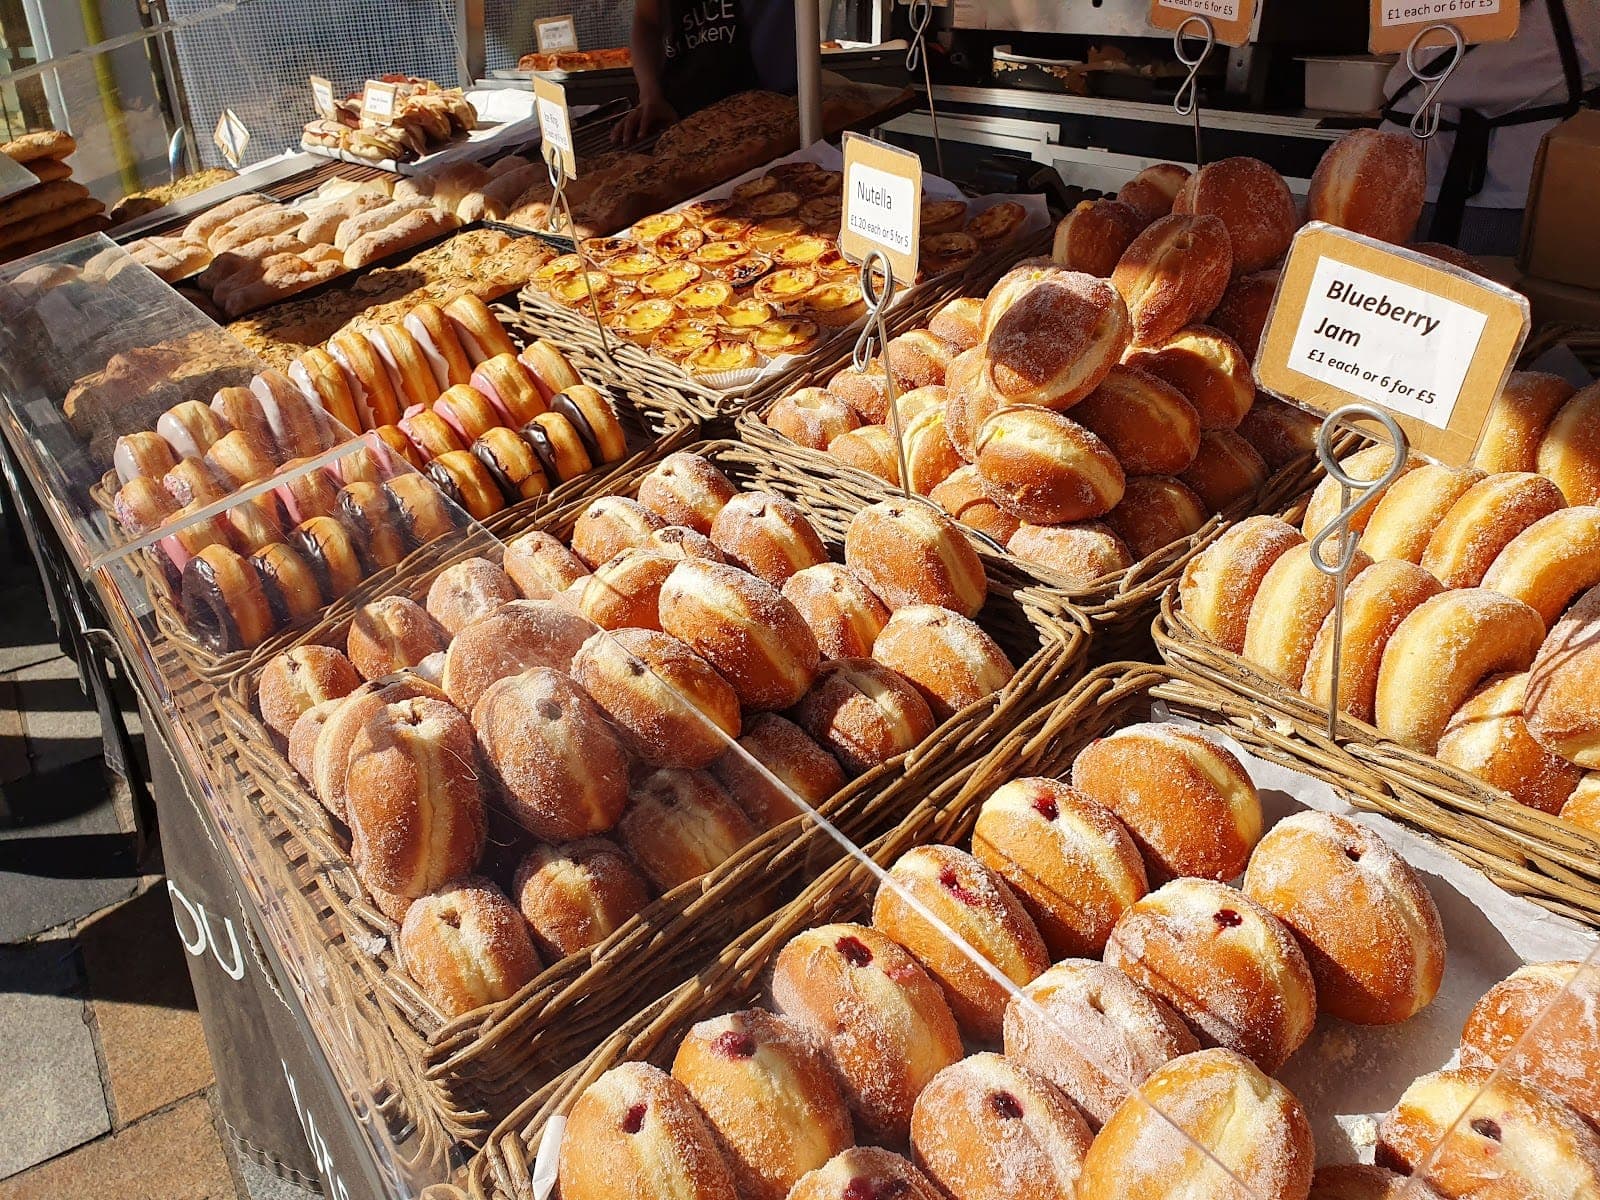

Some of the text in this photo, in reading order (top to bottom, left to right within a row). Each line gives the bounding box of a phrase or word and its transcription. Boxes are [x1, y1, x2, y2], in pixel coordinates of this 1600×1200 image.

[1204, 1, 1210, 10] 6
[1210, 2, 1222, 13] for
[1223, 5, 1233, 16] £5
[1388, 9, 1400, 20] £1
[1404, 3, 1431, 17] each
[1434, 3, 1447, 13] or
[1449, 0, 1457, 11] 6
[1459, 0, 1476, 9] for
[857, 180, 892, 210] Nutella
[850, 214, 867, 230] £1.20
[867, 223, 881, 236] each
[882, 228, 889, 238] or
[895, 230, 904, 246] for
[1326, 280, 1440, 337] Blueberry
[1314, 317, 1361, 347] Jam
[1307, 349, 1437, 405] £1 each or 6 for £5
